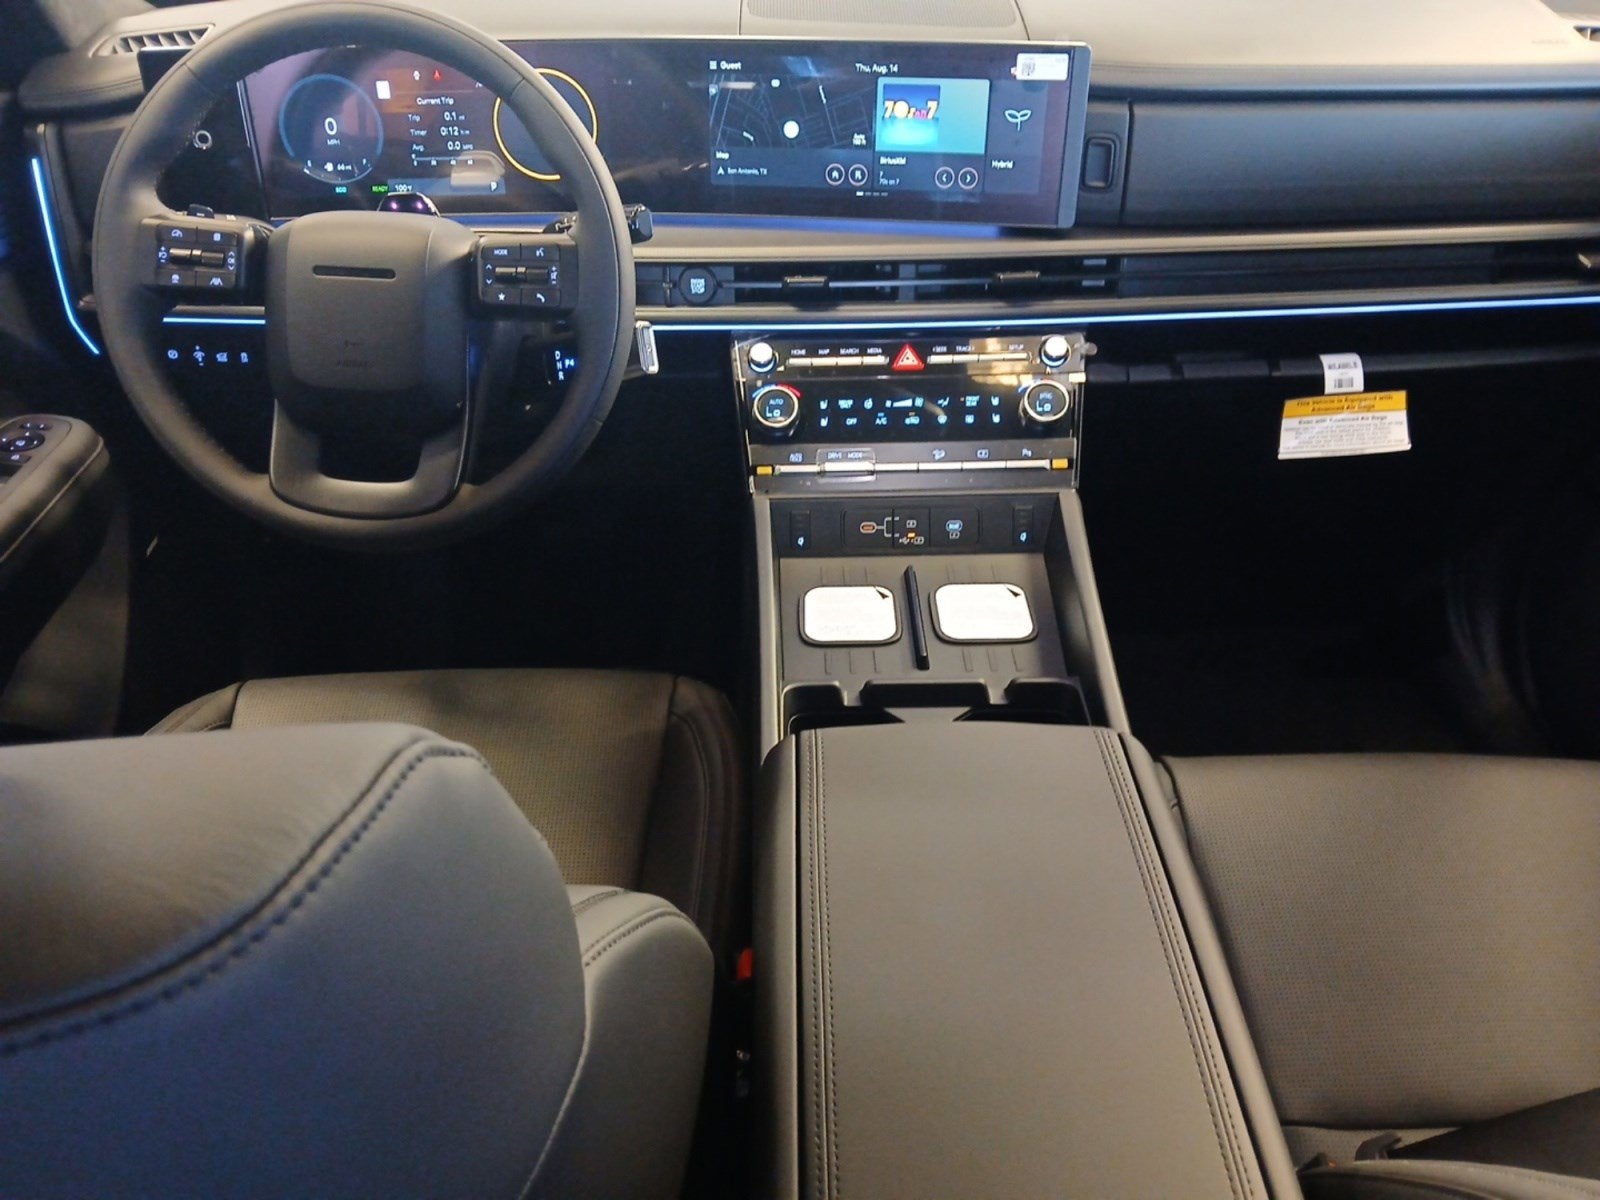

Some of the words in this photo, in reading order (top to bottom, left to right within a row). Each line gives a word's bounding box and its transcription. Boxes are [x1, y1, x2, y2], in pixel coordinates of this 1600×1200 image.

[720, 60, 742, 71] Guest
[855, 63, 871, 73] Thu,
[872, 64, 889, 75] Aug.
[890, 64, 898, 72] 14
[416, 96, 441, 105] Current
[441, 96, 454, 105] Trip
[408, 113, 421, 122] Trip
[444, 111, 457, 121] 0.1
[324, 117, 338, 135] 0
[410, 128, 427, 136] Timer
[440, 126, 459, 136] 0:12
[447, 141, 461, 151] 0.0
[991, 159, 1014, 169] Hybrid
[490, 181, 498, 191] P
[493, 248, 508, 256] MODE
[875, 416, 888, 425] A/C
